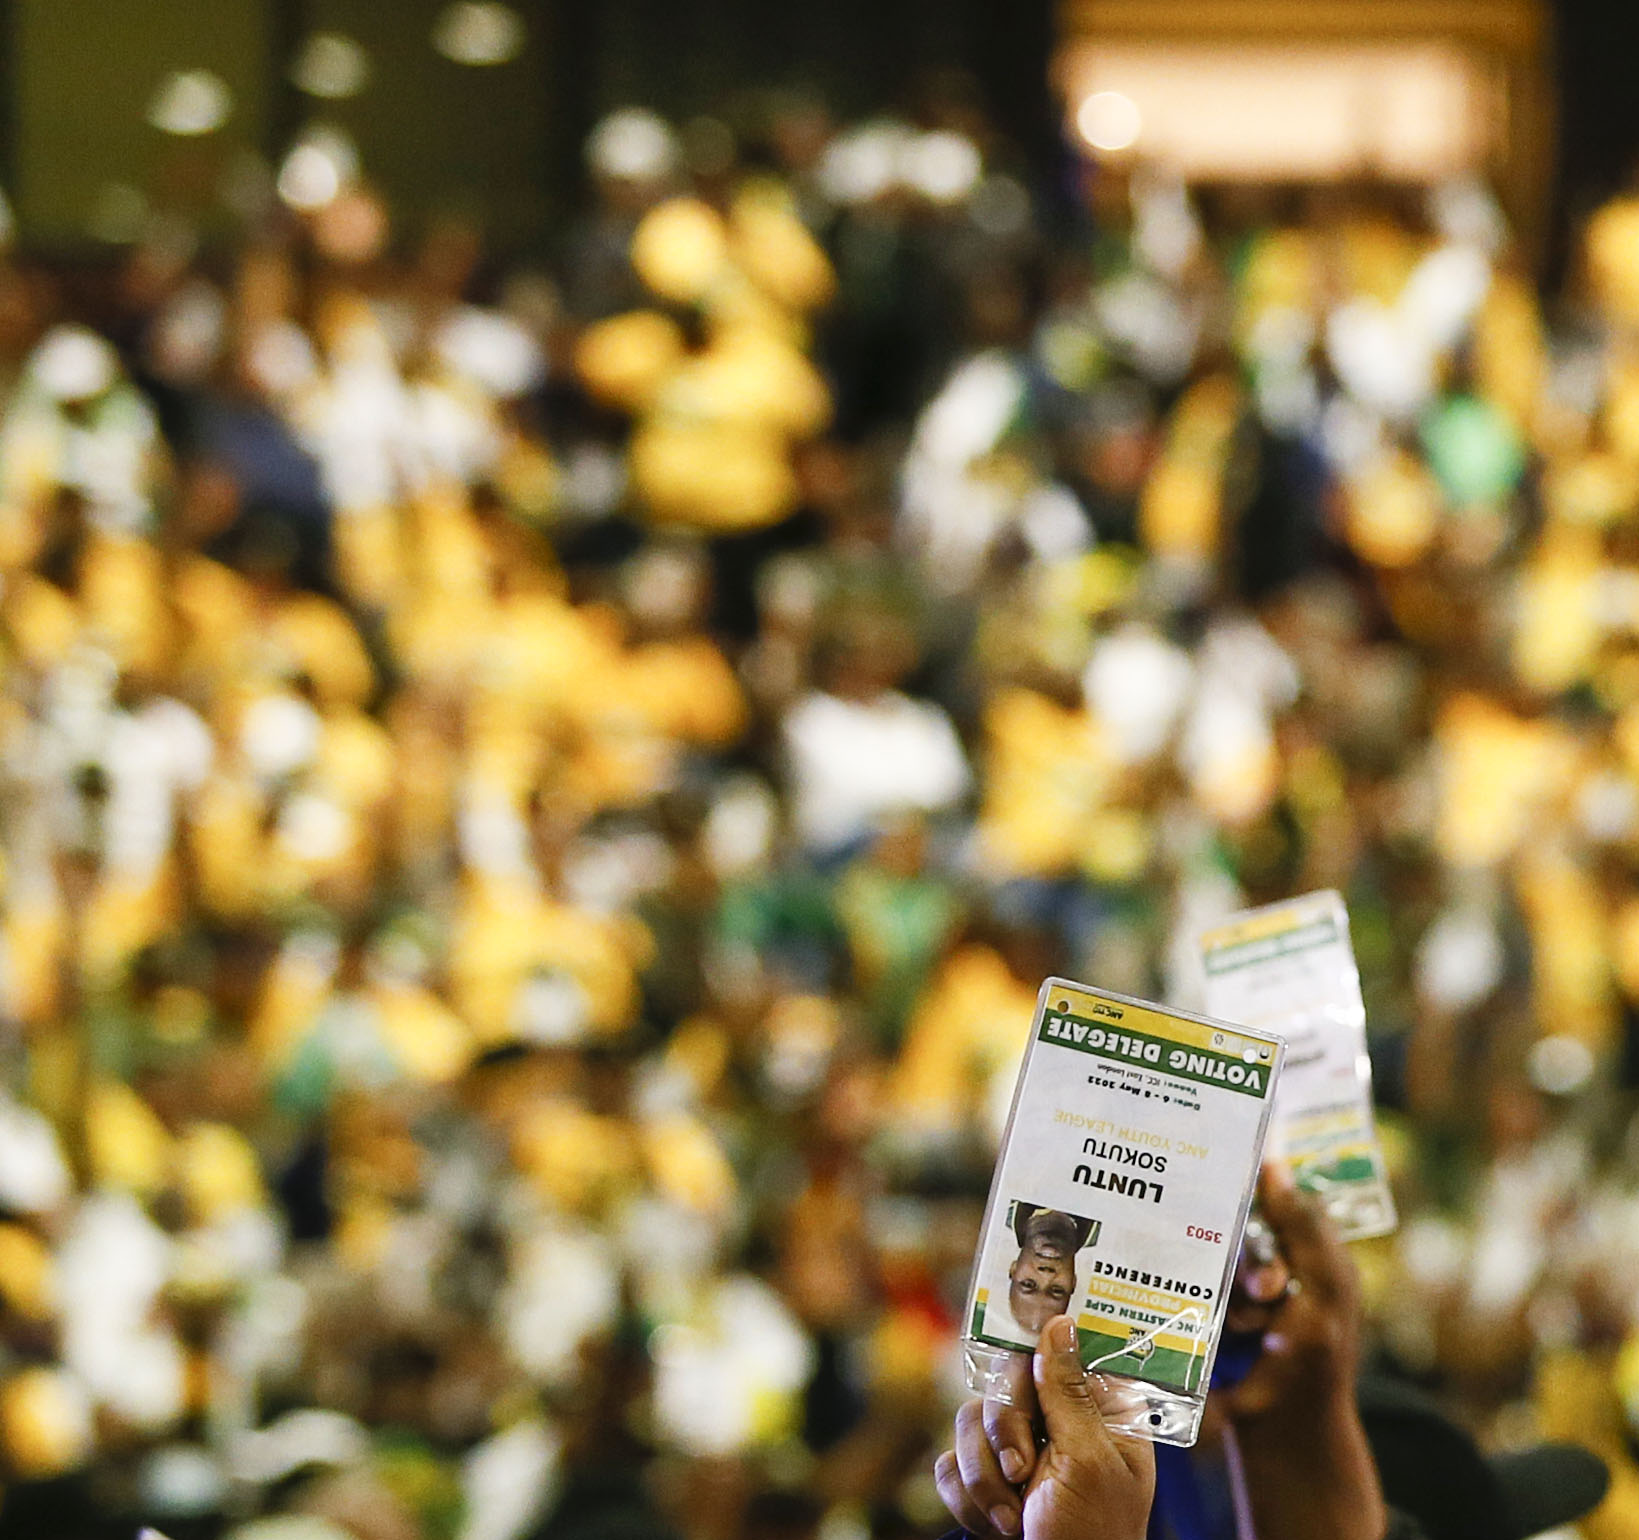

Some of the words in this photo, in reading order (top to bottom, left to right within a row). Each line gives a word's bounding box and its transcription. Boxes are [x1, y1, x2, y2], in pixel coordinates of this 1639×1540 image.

[1046, 1016, 1161, 1062] DELEGATE
[1166, 1048, 1262, 1089] VOTING
[1087, 1075, 1116, 1089] 2022
[1119, 1081, 1140, 1095] May
[1144, 1089, 1151, 1098] 8
[1162, 1094, 1170, 1103] 6
[1053, 1108, 1115, 1134] LEAGUE
[1117, 1126, 1172, 1149] YOUTH
[1082, 1137, 1167, 1173] SOKUTU
[1175, 1140, 1208, 1159] ANC
[1071, 1163, 1164, 1203] LUNTU
[1185, 1225, 1222, 1243] 3503
[1092, 1260, 1213, 1300] CONFERENCE
[1084, 1298, 1115, 1313] CAPE
[1128, 1326, 1145, 1337] ANC
